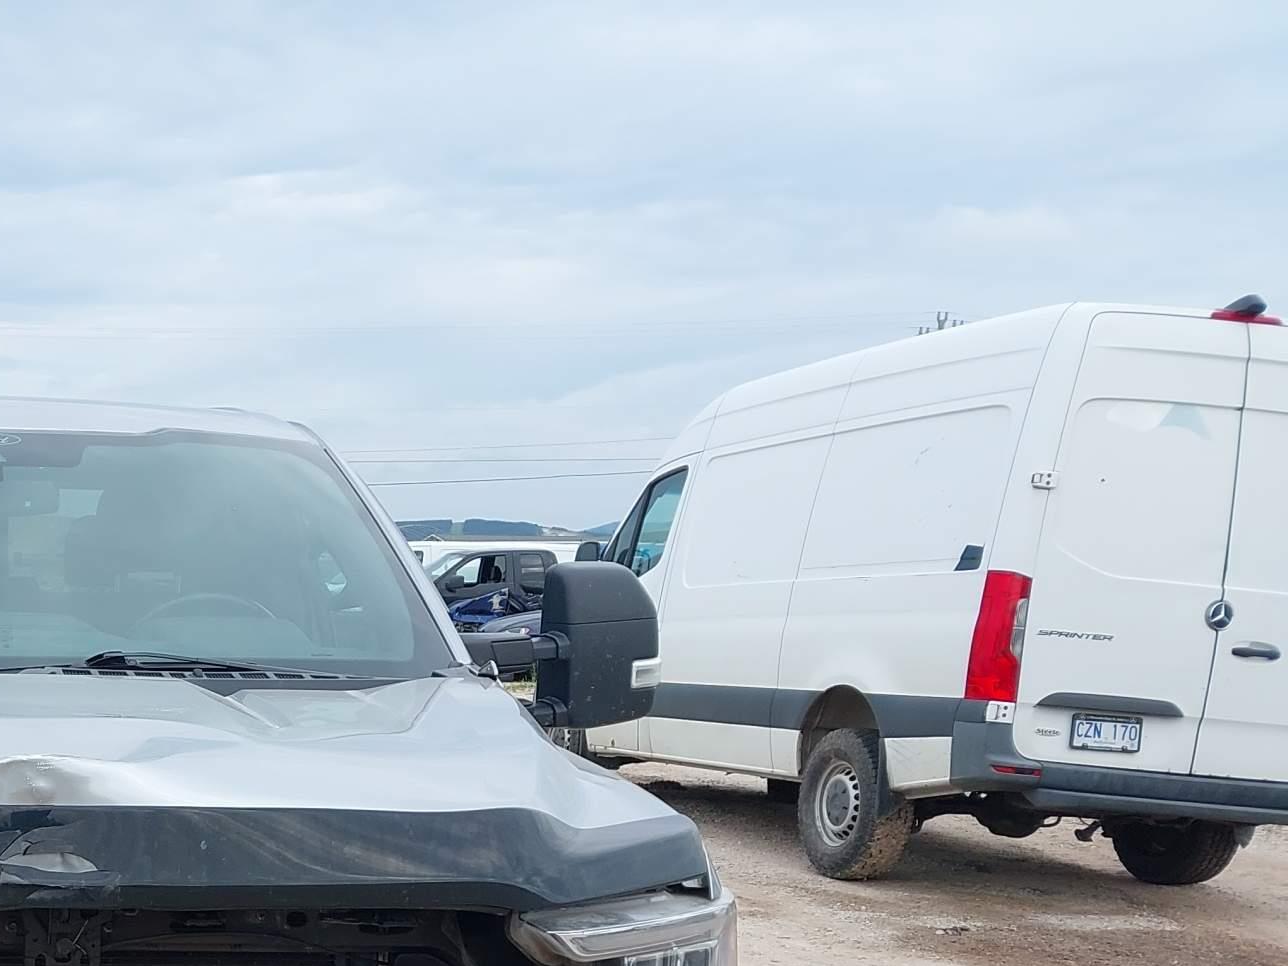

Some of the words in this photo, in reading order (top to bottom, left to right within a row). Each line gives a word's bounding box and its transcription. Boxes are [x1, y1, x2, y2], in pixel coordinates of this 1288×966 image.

[1037, 629, 1115, 641] SPRINTER
[1076, 721, 1103, 739] CZN
[1113, 724, 1138, 741] 170
